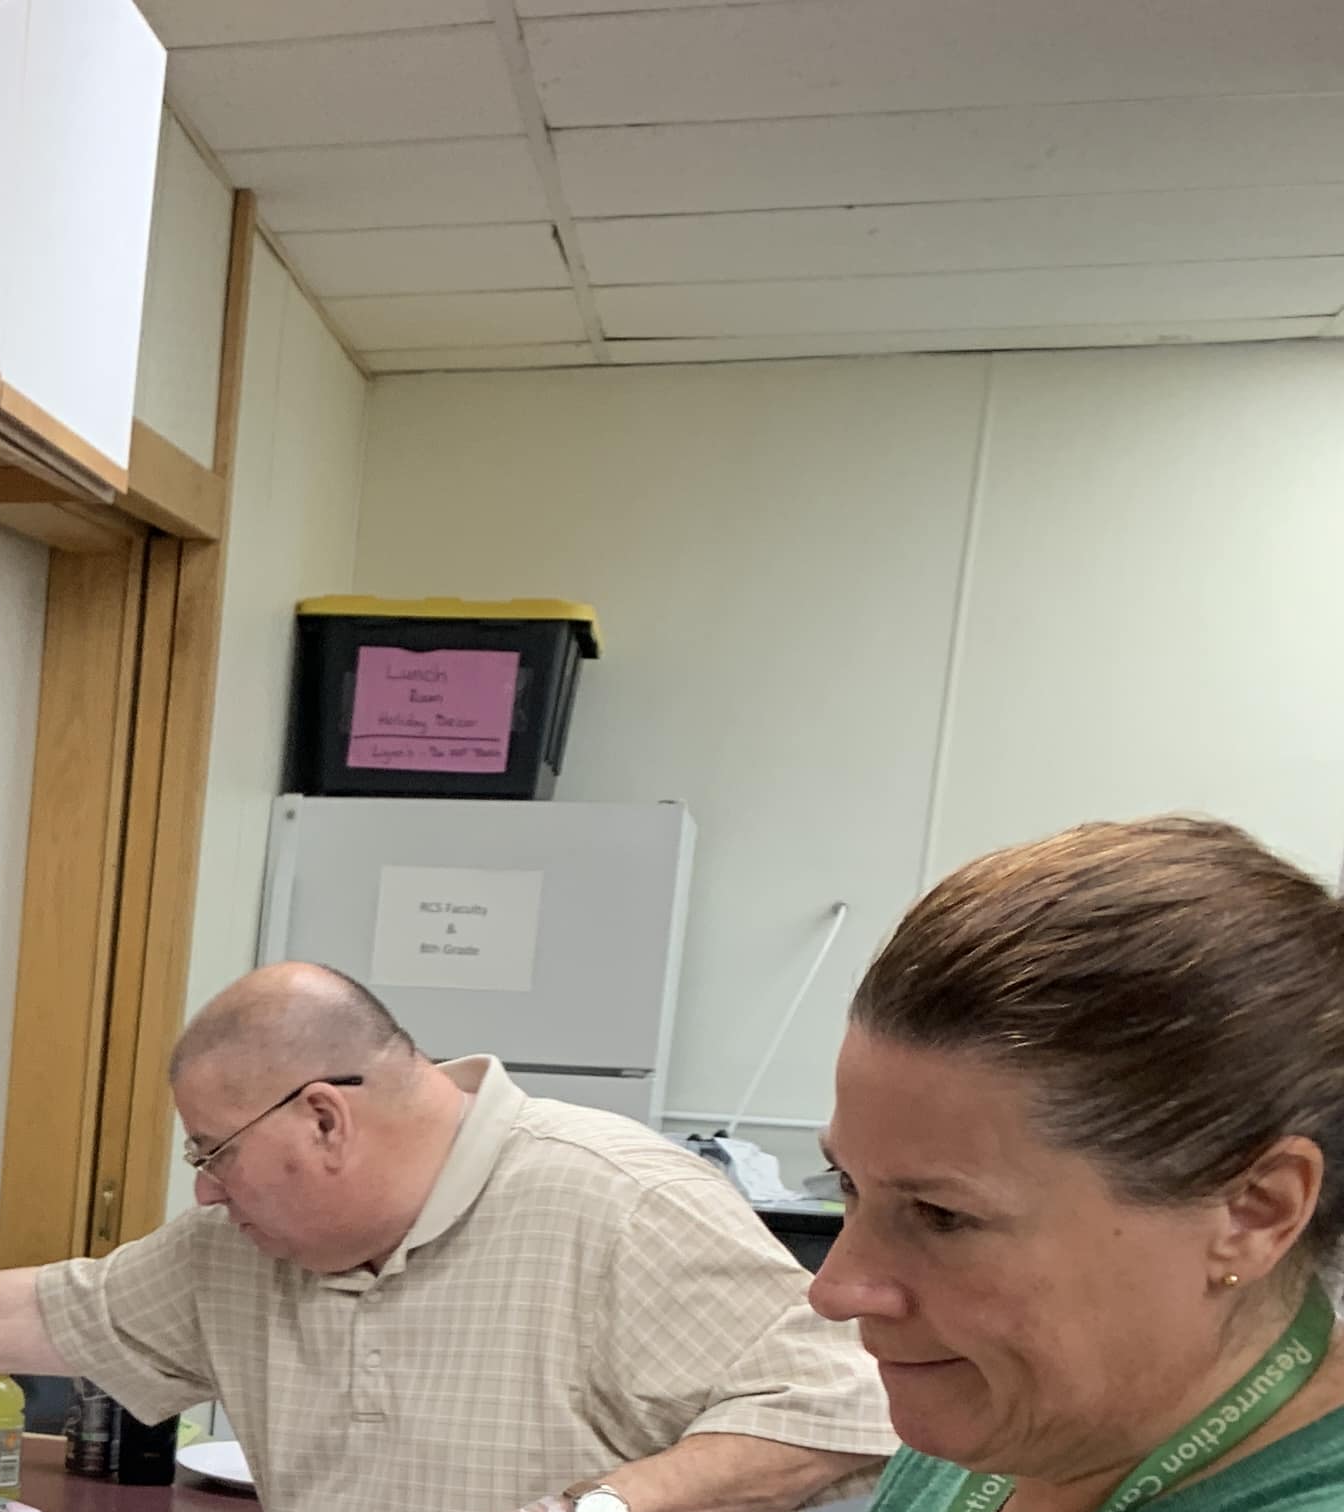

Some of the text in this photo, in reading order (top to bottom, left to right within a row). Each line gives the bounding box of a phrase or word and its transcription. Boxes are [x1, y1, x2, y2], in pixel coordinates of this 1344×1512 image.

[385, 663, 449, 683] Lunch
[419, 901, 488, 918] RCS Faculty
[446, 923, 457, 935] &
[442, 943, 480, 957] Grade
[1159, 1336, 1313, 1474] Resurrection
